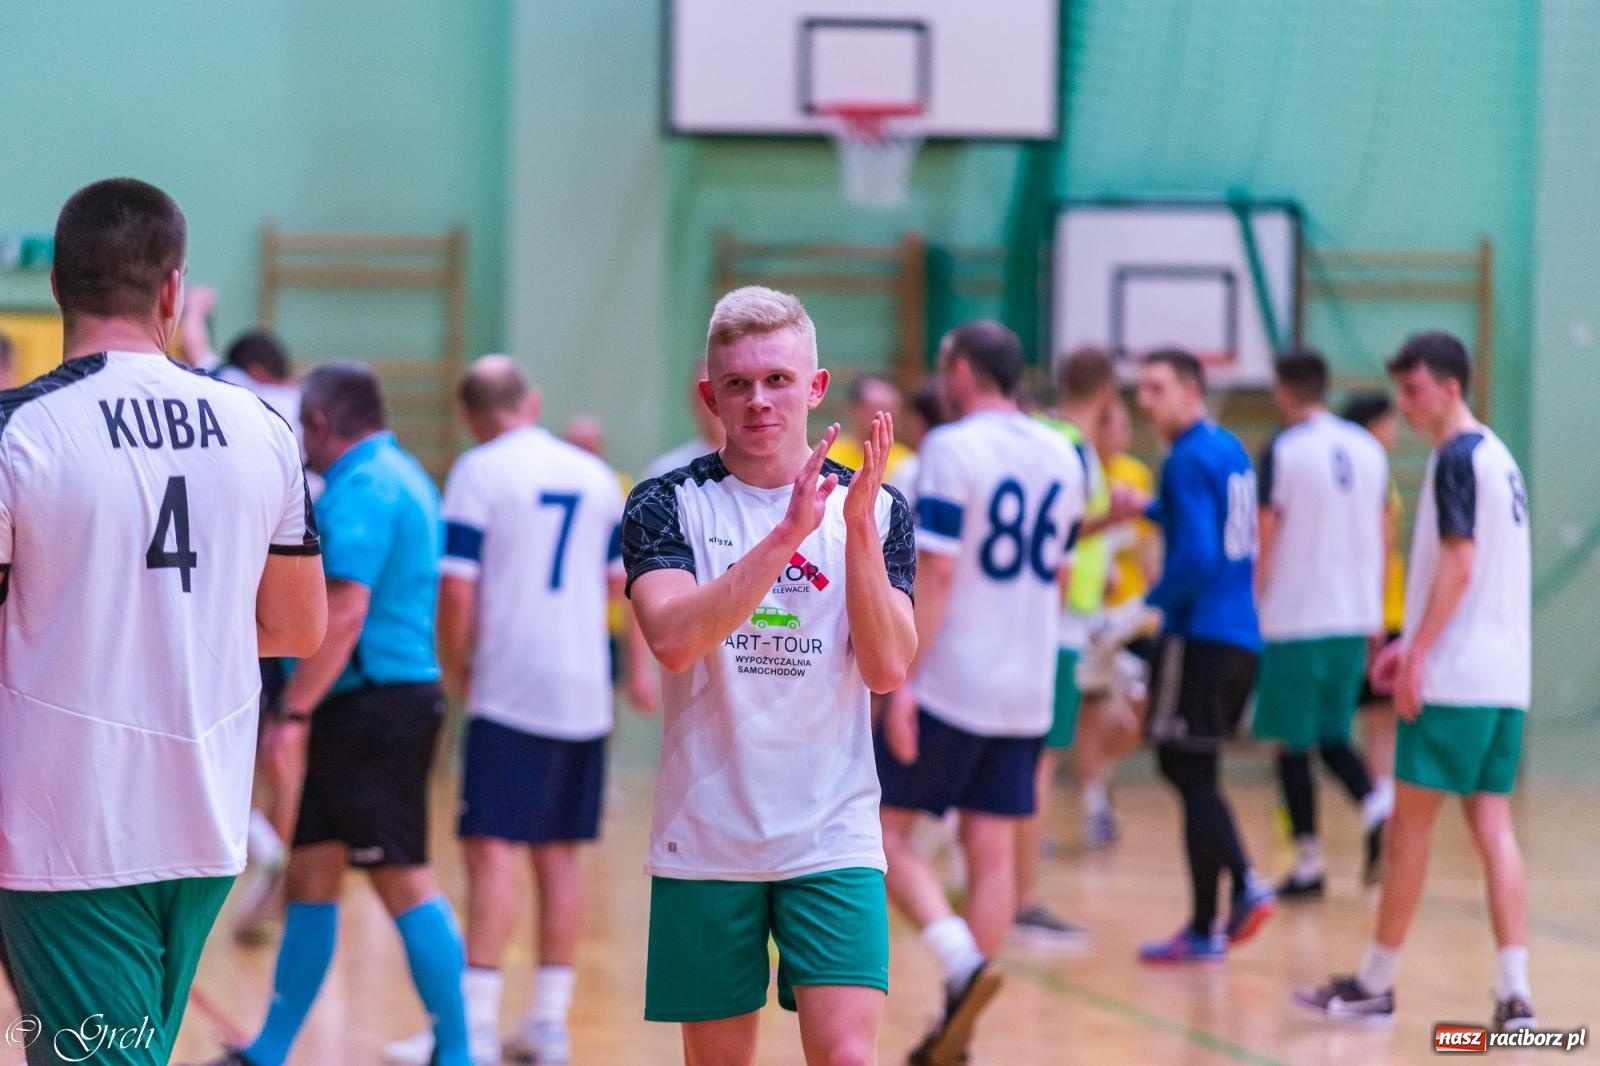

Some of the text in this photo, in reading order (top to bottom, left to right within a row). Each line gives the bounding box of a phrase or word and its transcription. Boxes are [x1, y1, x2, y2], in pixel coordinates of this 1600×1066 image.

[98, 397, 228, 450] KUBA
[146, 475, 197, 593] 4
[979, 477, 1061, 583] 86
[539, 491, 579, 592] 7
[708, 537, 733, 547] KISTA
[772, 586, 810, 594] ELEWACJE
[725, 634, 823, 654] ART-TOUR
[735, 655, 812, 667] WYPOŻYCZALNIA
[737, 665, 806, 677] SAMOCHODÓW
